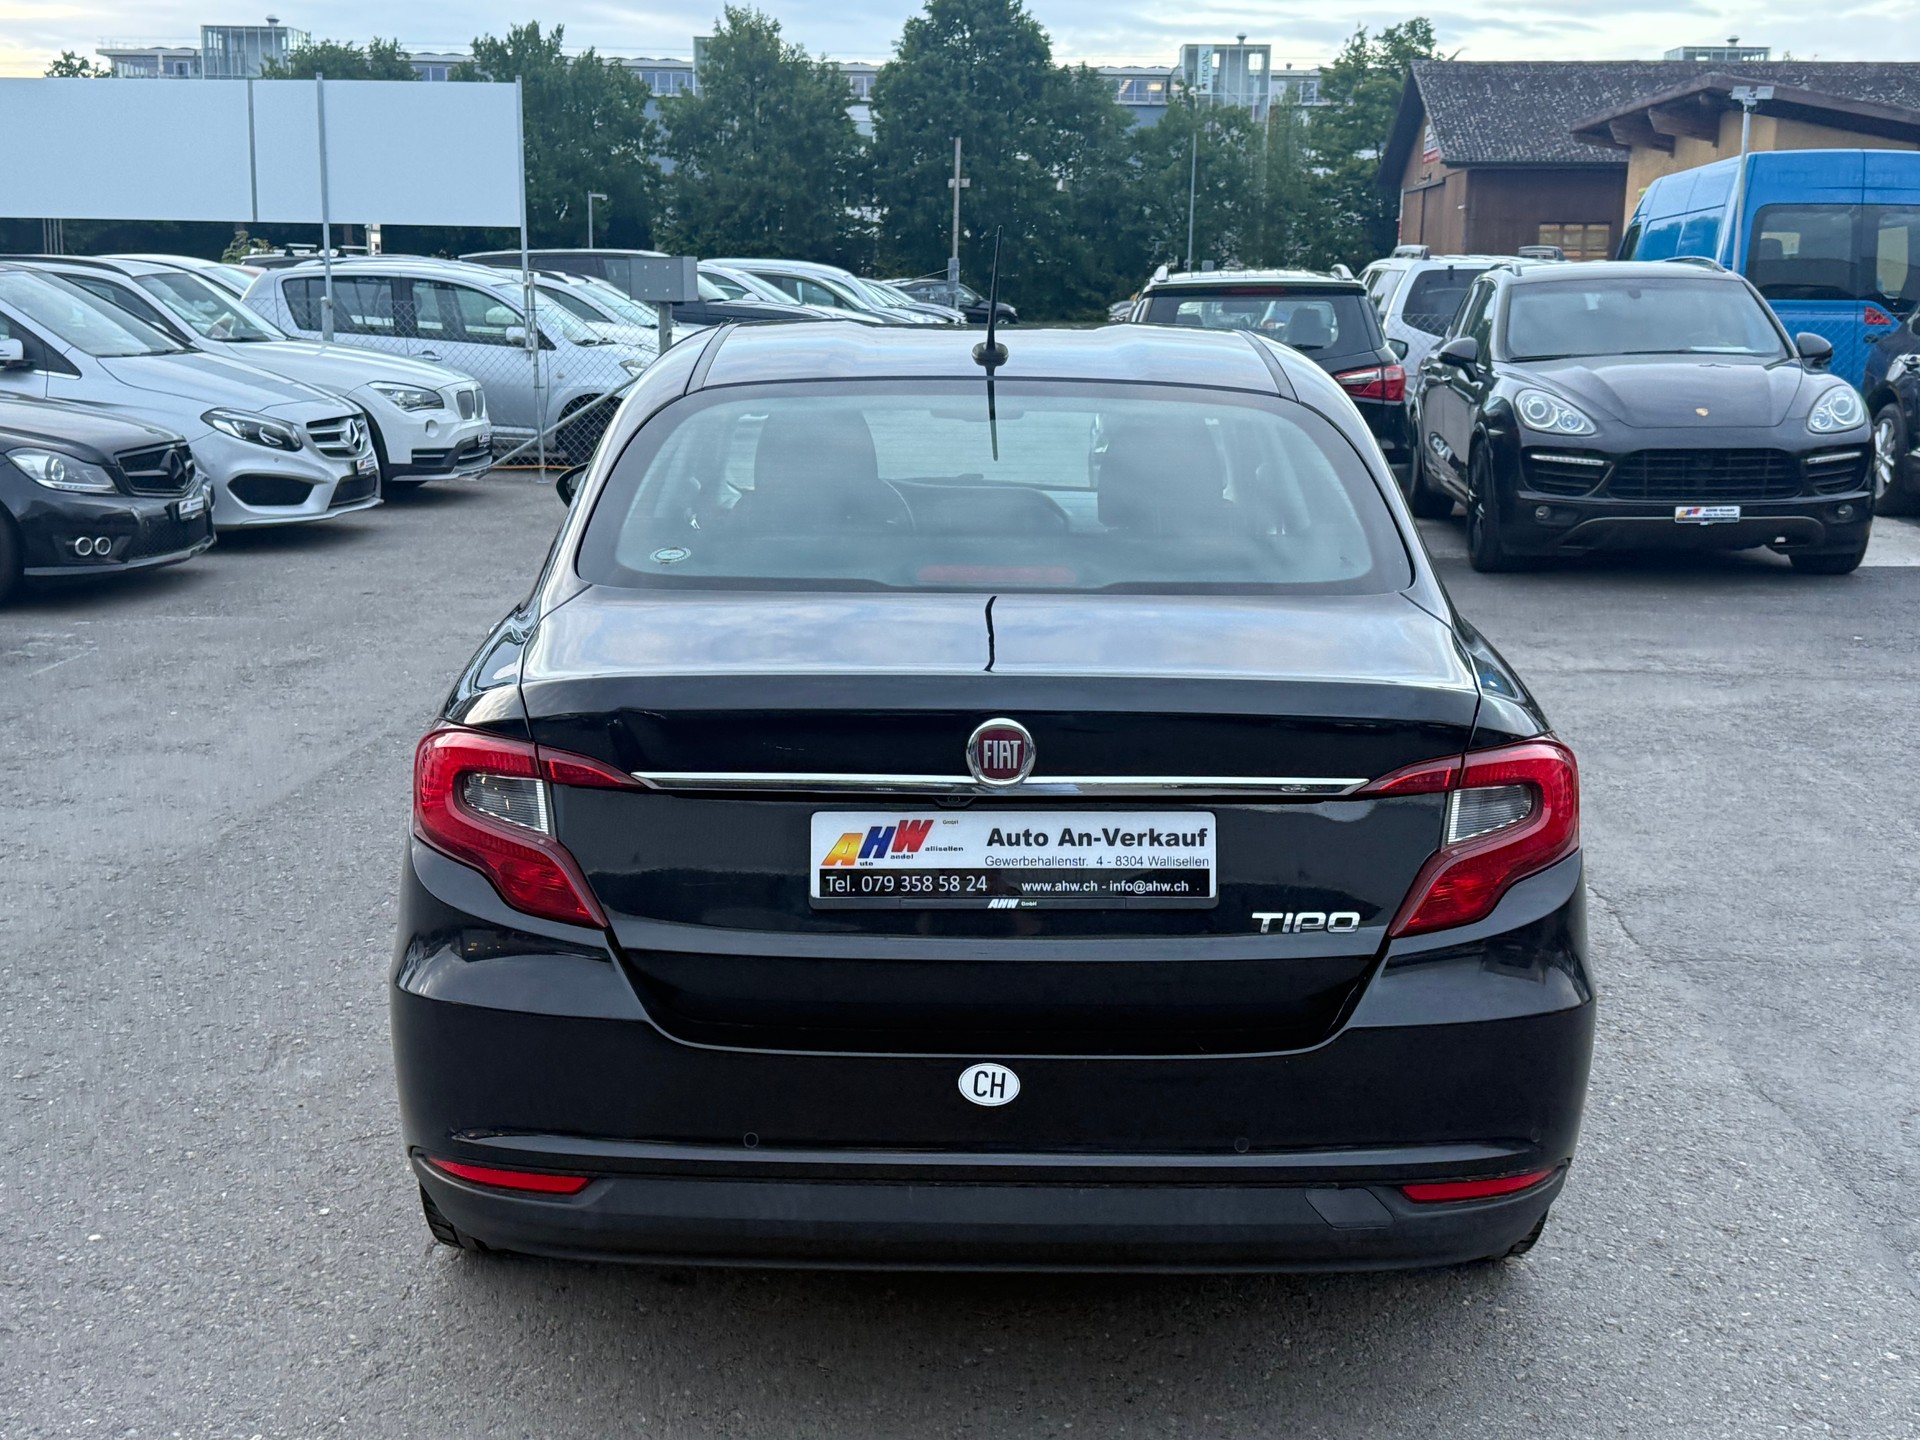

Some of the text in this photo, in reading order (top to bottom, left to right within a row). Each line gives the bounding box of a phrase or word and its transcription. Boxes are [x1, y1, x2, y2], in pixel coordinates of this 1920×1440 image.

[983, 740, 1021, 769] FIAT
[821, 820, 934, 866] AHW
[986, 828, 1208, 847] Auto An-Verkauf
[985, 855, 1089, 867] Gewerbehallenstr.
[1096, 856, 1103, 866] 4
[1115, 856, 1144, 867] 8304
[1148, 856, 1209, 867] Wallisellen
[826, 875, 987, 892] Tel. 079 358 58 24
[1021, 880, 1098, 892] www.ahw.ch
[1109, 880, 1189, 894] info@ahw.ch
[987, 899, 1019, 909] AHW
[1252, 912, 1360, 934] TIPO
[973, 1070, 1006, 1099] CH
